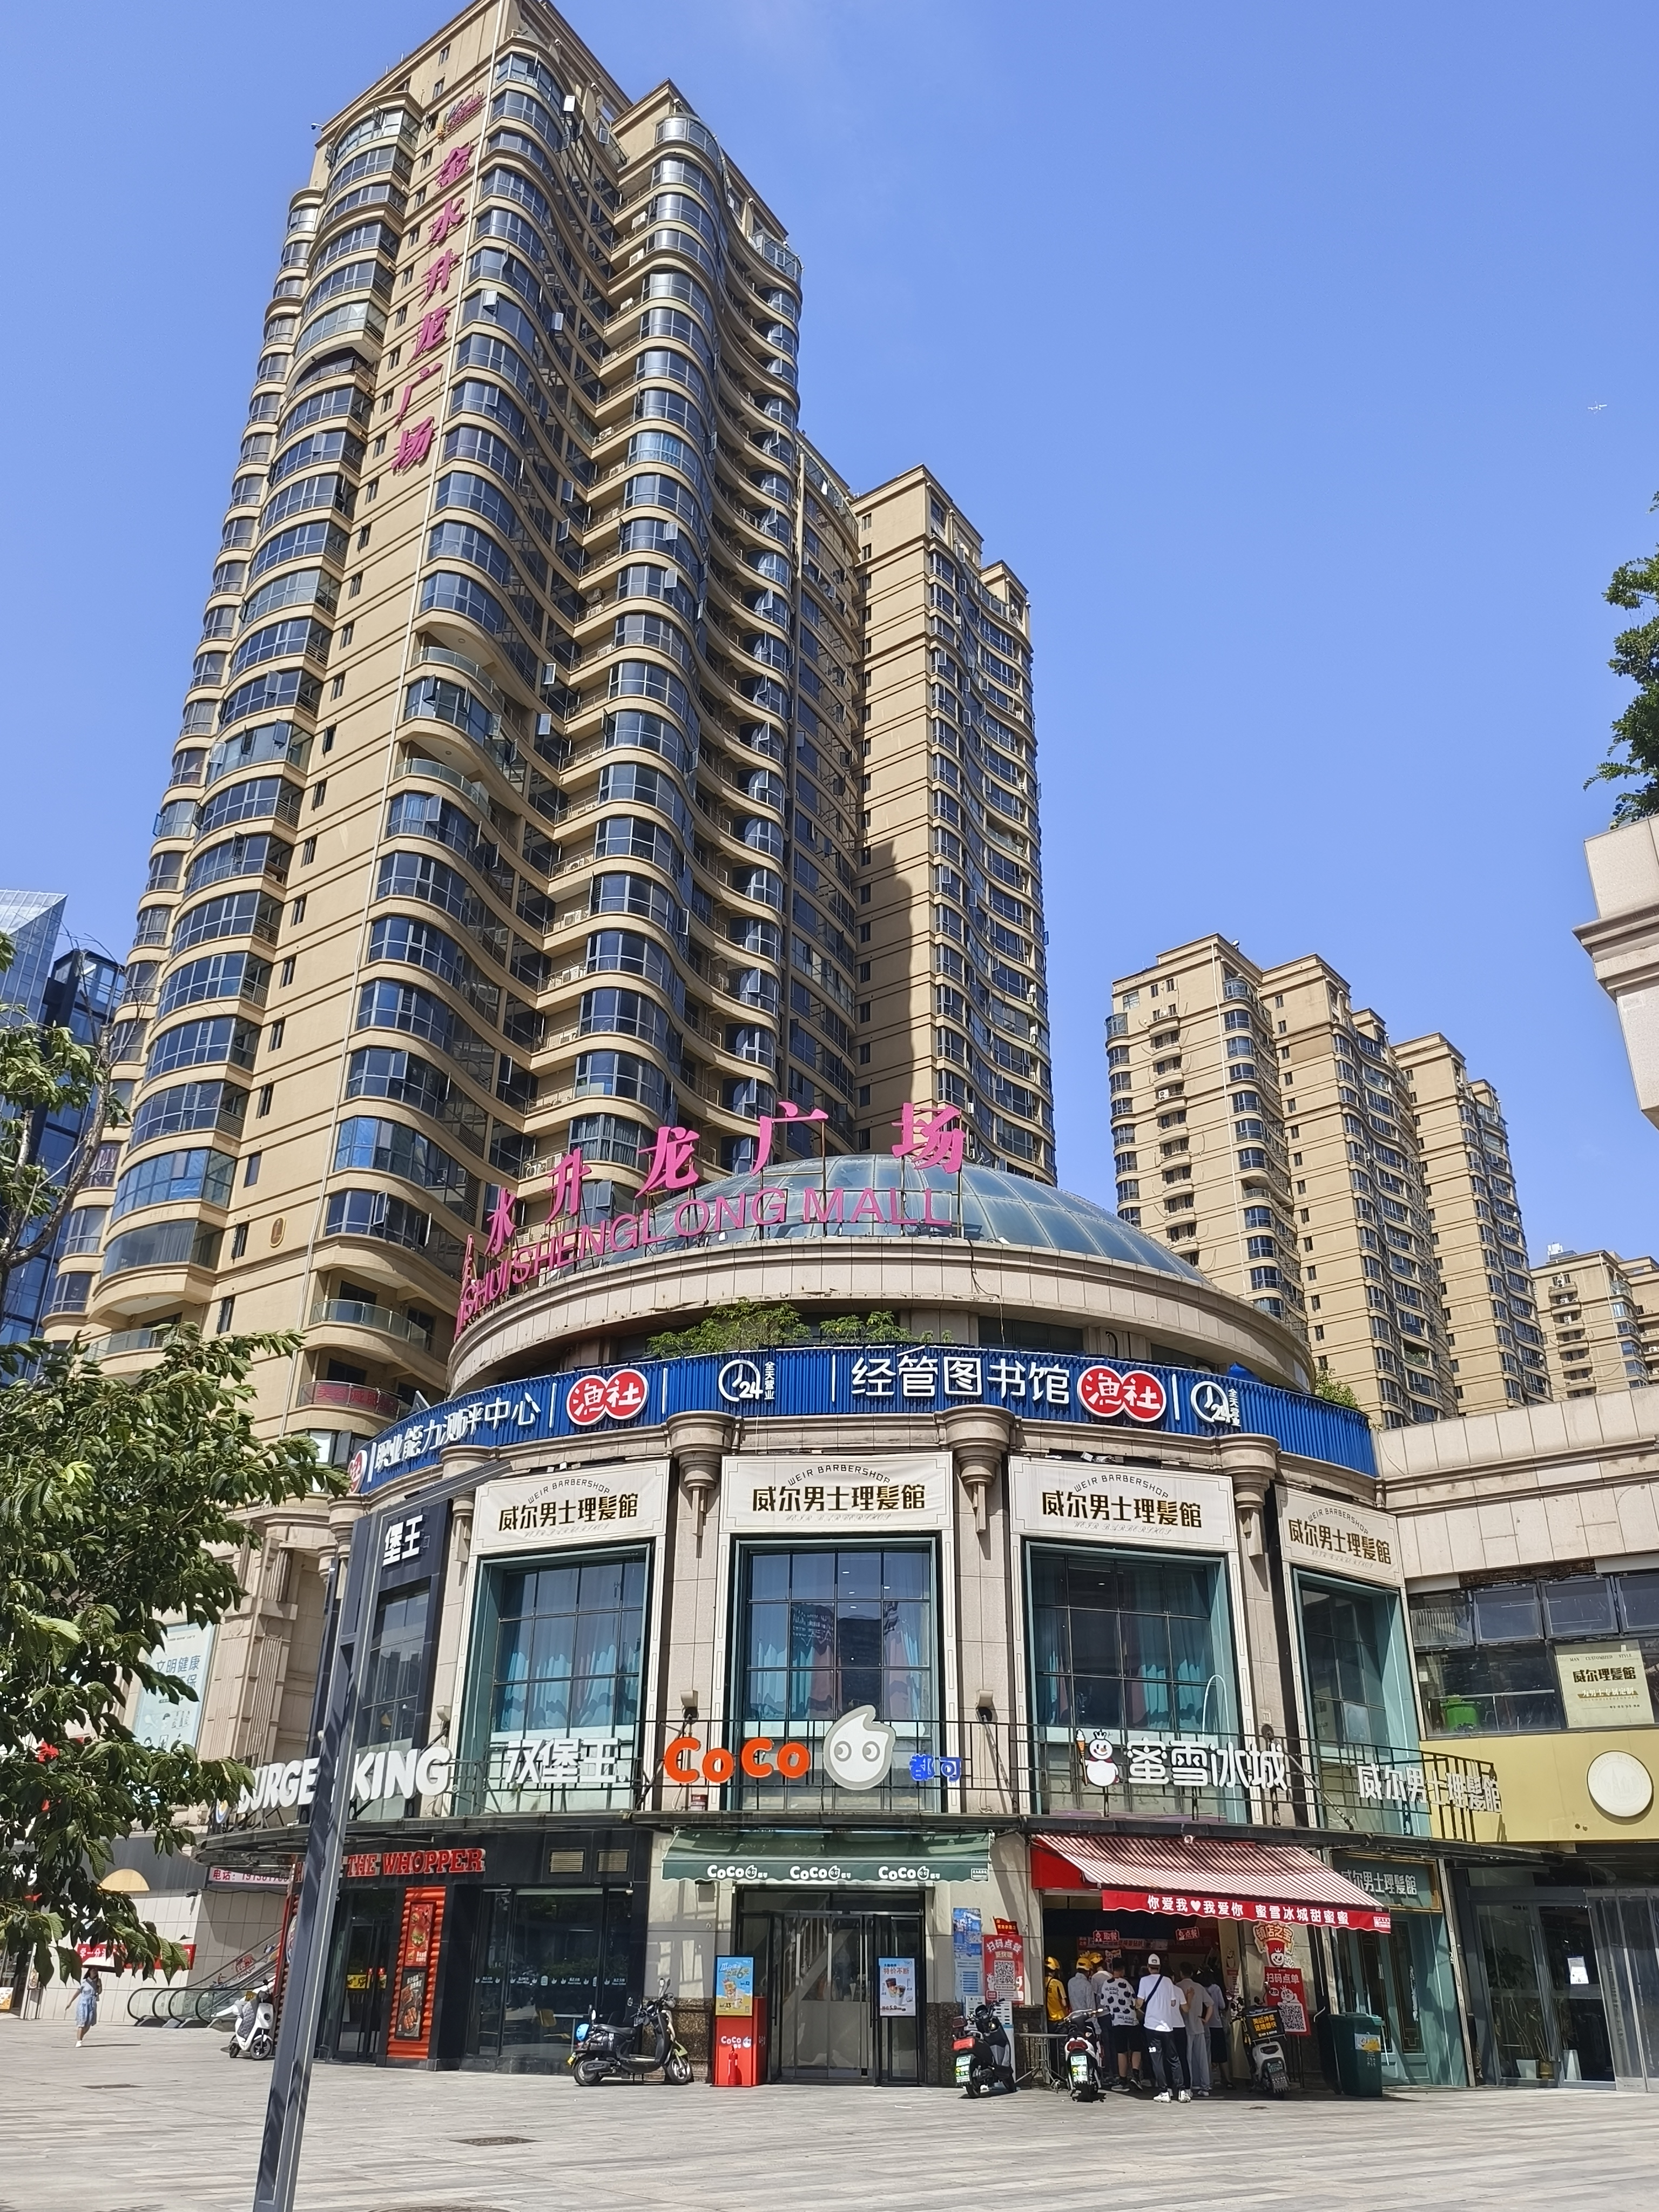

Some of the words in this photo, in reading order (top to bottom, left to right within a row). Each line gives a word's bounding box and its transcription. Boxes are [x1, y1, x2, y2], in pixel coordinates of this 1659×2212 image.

[460, 1102, 966, 1300] 水升龙广场
[804, 1187, 951, 1226] MALL
[852, 1355, 1069, 1404] 经管图书馆
[374, 1392, 541, 1473] 职业能力测评中心
[788, 1469, 814, 1486] WEIR
[818, 1464, 891, 1484] BARBERSHOP
[1074, 1477, 1098, 1492] WEIR
[1101, 1474, 1169, 1498] BARBERSHOP
[528, 1486, 549, 1504] WEIR
[552, 1479, 610, 1494] BARBERSHOP
[1307, 1509, 1323, 1522] WEIR
[1325, 1507, 1369, 1535] BARBERSHOP
[382, 1514, 423, 1566] 堡王
[156, 1655, 201, 1673] 文明健康
[350, 1746, 452, 1800] KING
[505, 1737, 621, 1784] 汉堡王
[664, 1737, 811, 1783] CoCo
[909, 1754, 962, 1782] 都可
[1127, 1737, 1288, 1791] 蜜雪冰城
[347, 1853, 381, 1878] THE
[382, 1848, 487, 1876] WHOPPER
[707, 1865, 744, 1879] CoCo
[790, 1865, 828, 1880] CoCo
[878, 1866, 916, 1880] CoCo
[1255, 1904, 1350, 1925] 蜜雪冰城甜蜜蜜
[986, 1938, 1022, 1954] 扫码点餐
[1103, 1932, 1118, 1941] 取餐
[1256, 1924, 1293, 1943] 镇店之宝
[1266, 1973, 1299, 1984] 扫码点单
